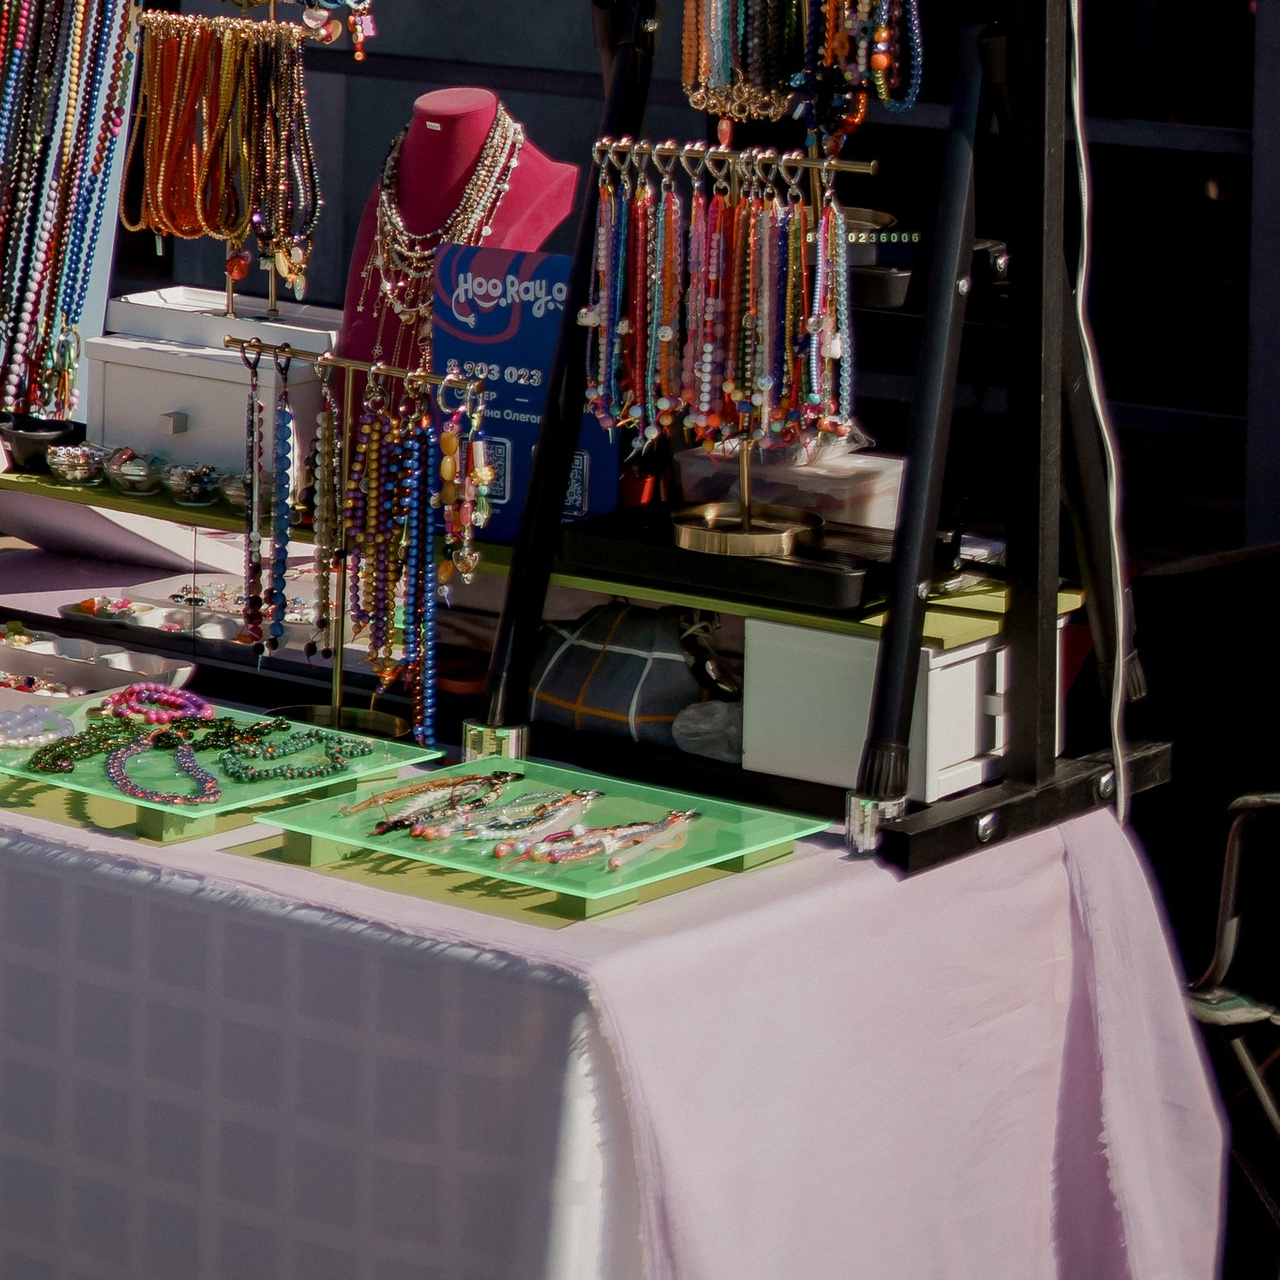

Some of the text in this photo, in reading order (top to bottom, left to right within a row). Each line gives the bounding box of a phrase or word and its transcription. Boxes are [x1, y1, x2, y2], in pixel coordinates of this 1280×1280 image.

[452, 272, 567, 323] Hoo.Ray.o
[463, 360, 500, 381] 903
[504, 366, 542, 387] 023
